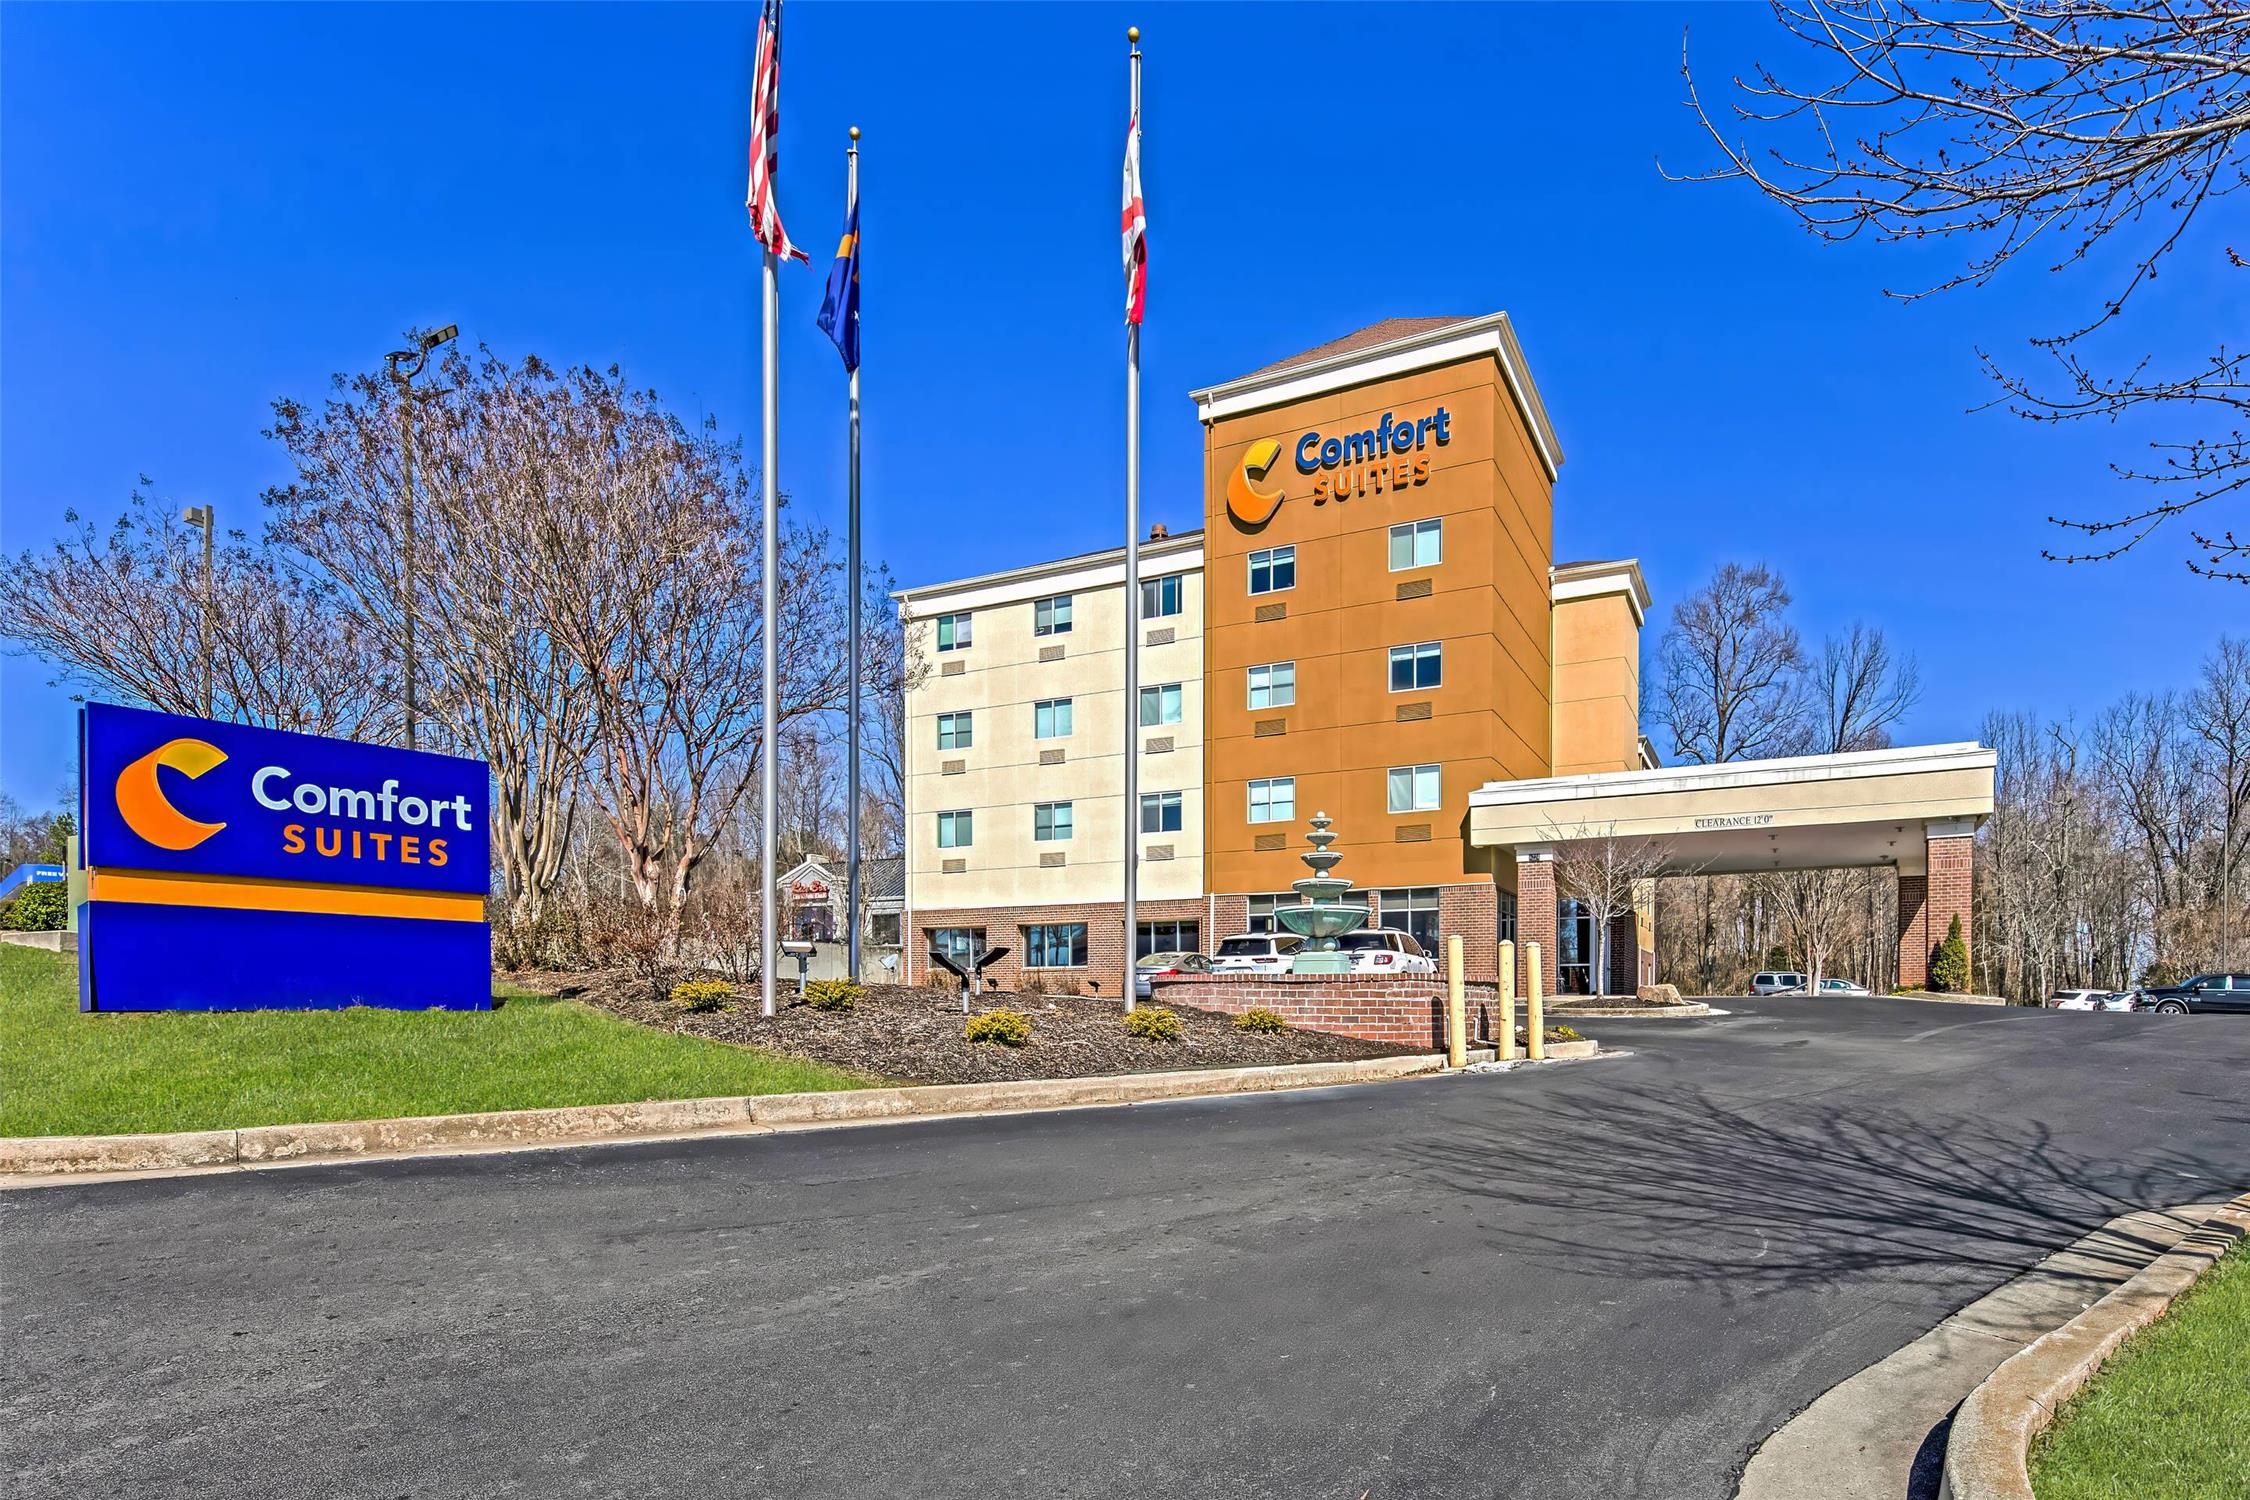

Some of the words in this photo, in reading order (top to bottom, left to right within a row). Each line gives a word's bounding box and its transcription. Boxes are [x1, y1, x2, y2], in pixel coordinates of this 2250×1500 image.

[1296, 407, 1450, 471] Comfort
[1314, 452, 1431, 504] SUITES
[252, 766, 472, 831] Comfort
[1695, 816, 1751, 828] CLEARANCE
[283, 824, 448, 867] SUITES
